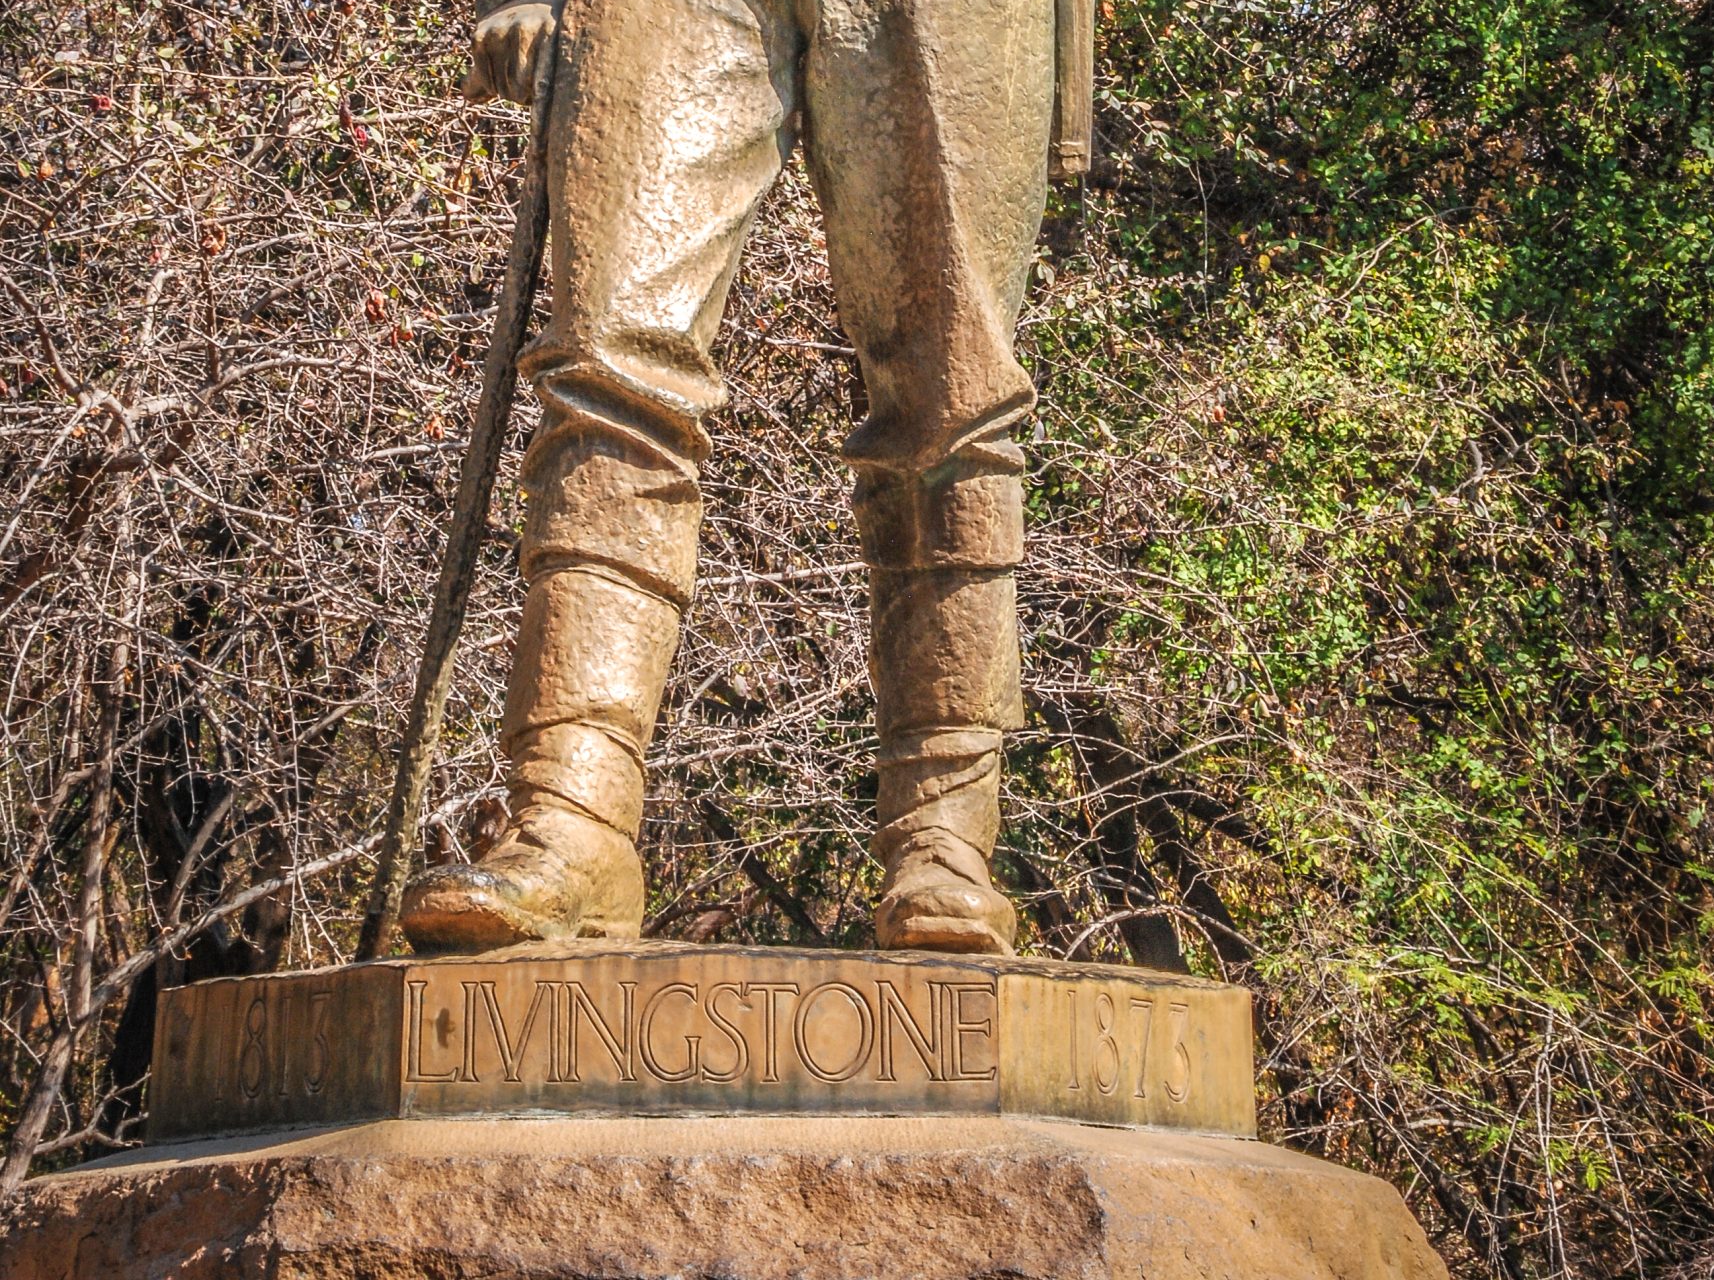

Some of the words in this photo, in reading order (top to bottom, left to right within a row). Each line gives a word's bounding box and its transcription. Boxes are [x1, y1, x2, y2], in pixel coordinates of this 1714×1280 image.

[215, 991, 333, 1101] 1813
[404, 980, 997, 1084] LIVINGSTONE
[1067, 989, 1192, 1104] 1873
